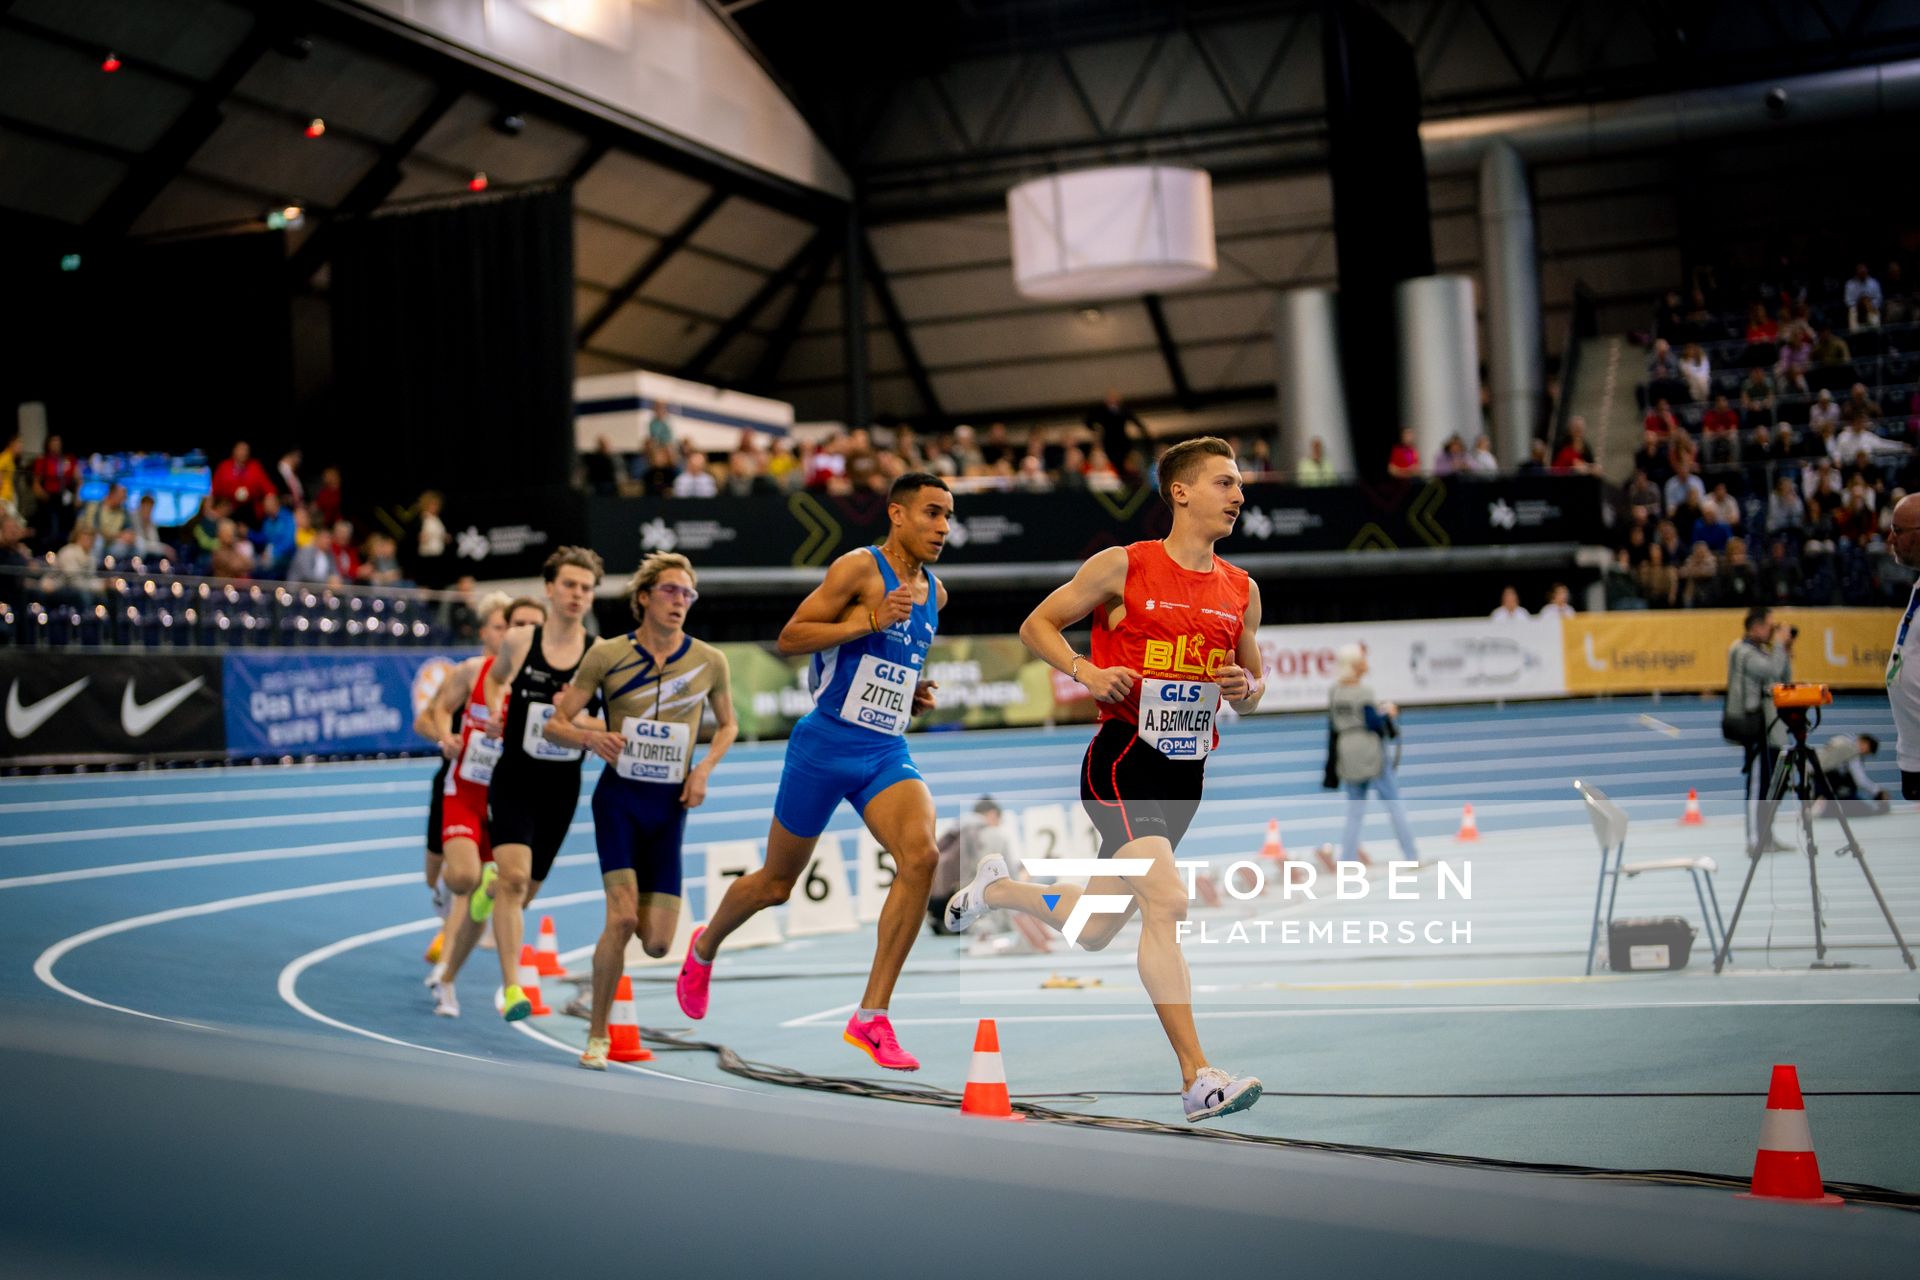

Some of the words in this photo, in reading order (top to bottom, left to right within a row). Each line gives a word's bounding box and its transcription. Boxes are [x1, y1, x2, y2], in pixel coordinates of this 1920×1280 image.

[861, 683, 905, 713] ZITTEL
[1161, 684, 1202, 702] GLS
[876, 714, 896, 724] PLAN
[1145, 709, 1211, 732] A.BEIMLER
[636, 723, 671, 739] GLS
[1175, 740, 1195, 749] PLAN
[878, 851, 897, 888] 5
[806, 859, 828, 901] 6
